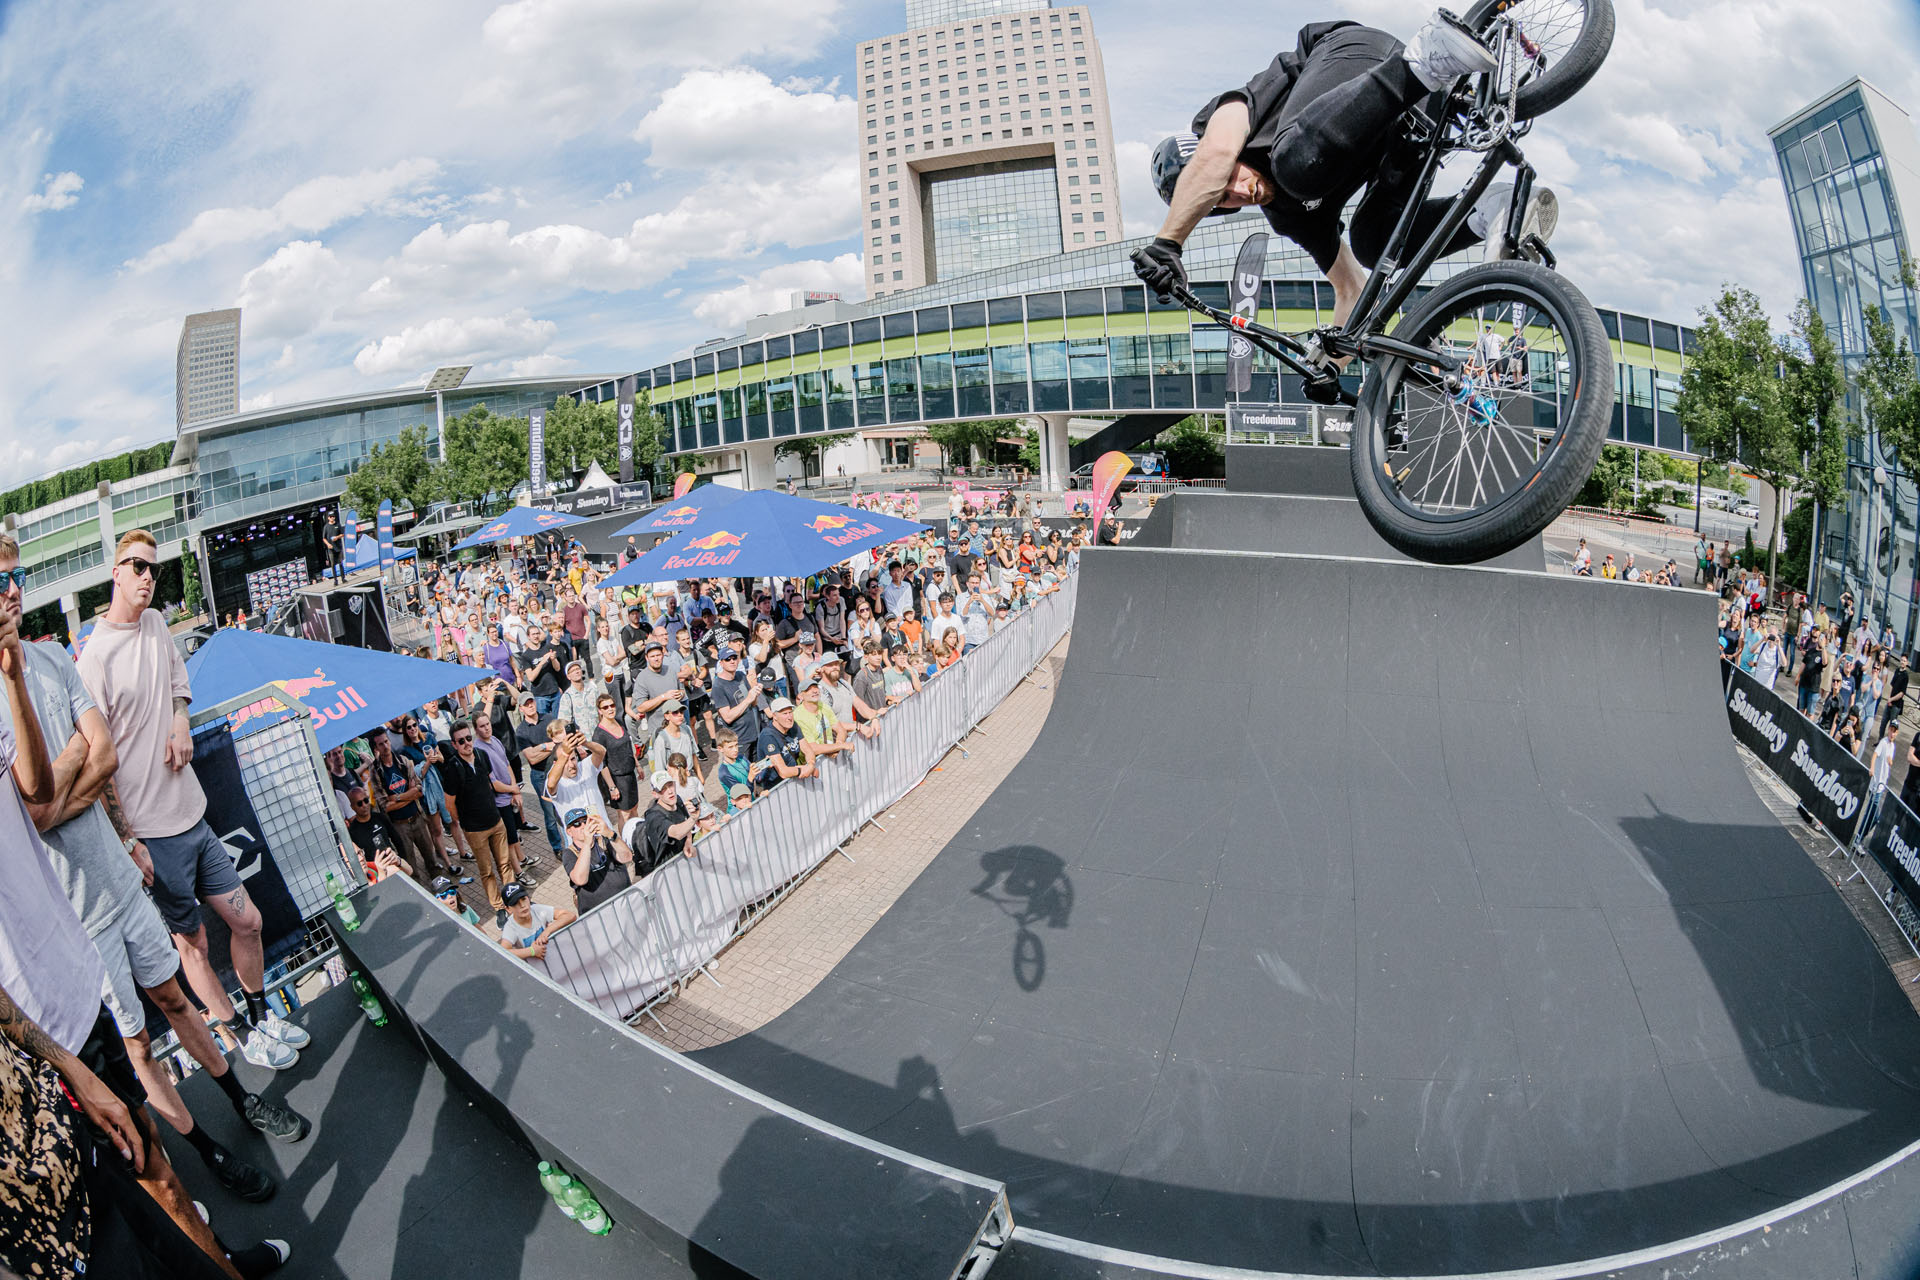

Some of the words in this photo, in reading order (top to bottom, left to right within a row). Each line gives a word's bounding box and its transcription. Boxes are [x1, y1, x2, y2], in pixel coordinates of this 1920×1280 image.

[1242, 413, 1297, 426] freedombmx
[1323, 417, 1353, 432] Sun
[576, 496, 609, 509] Sunday
[308, 686, 368, 730] Bull
[1729, 688, 1788, 753] Sunday
[1790, 738, 1859, 820] Sunday
[1886, 824, 1920, 886] freedo
